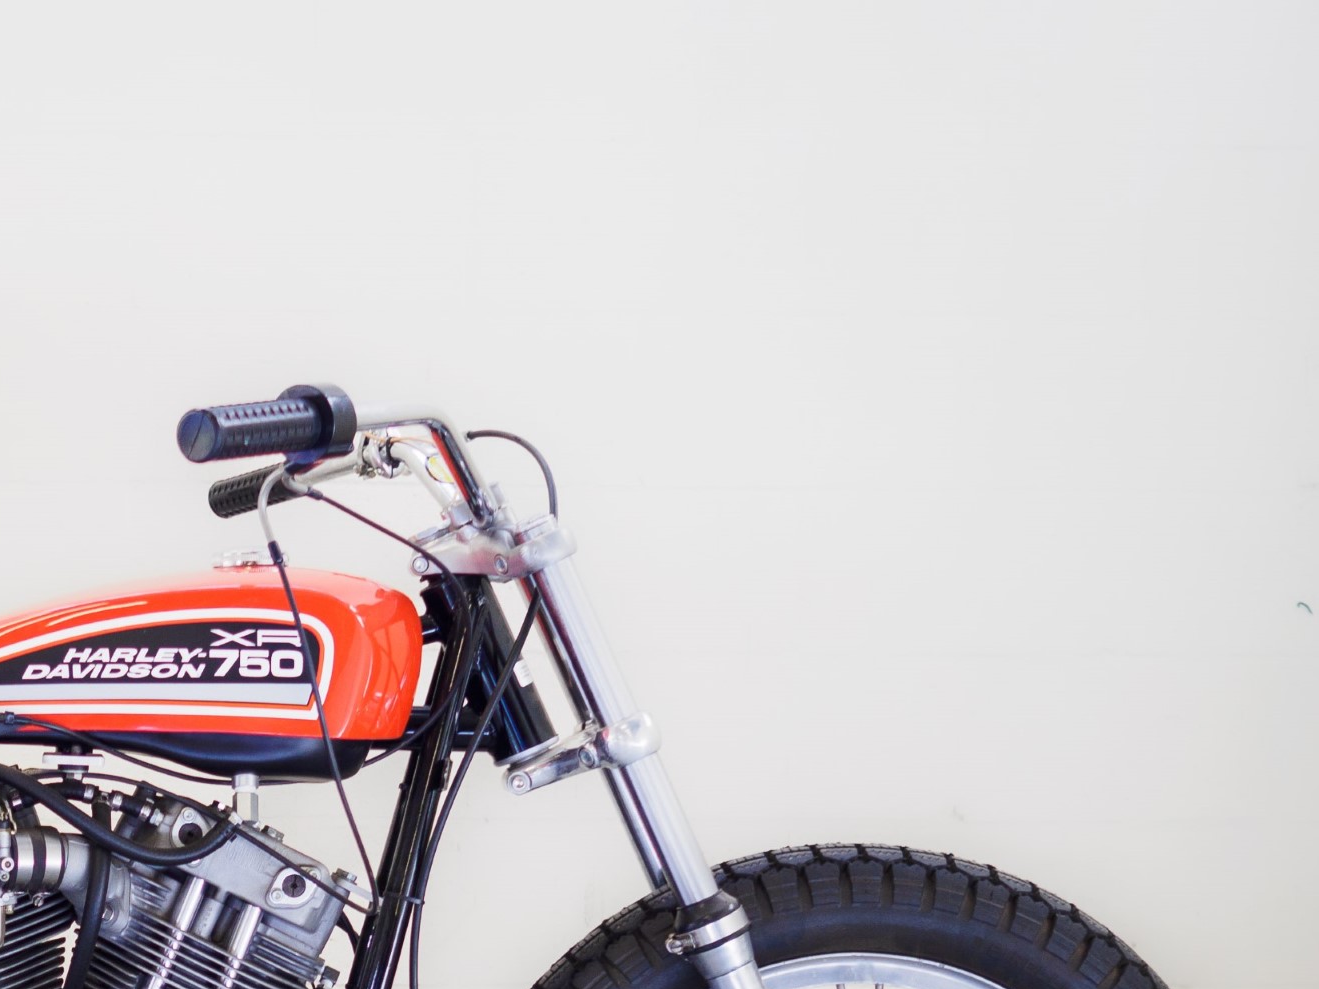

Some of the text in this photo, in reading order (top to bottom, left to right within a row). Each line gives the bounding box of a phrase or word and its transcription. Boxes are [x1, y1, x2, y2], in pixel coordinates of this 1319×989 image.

[210, 628, 302, 647] XR
[63, 648, 207, 663] HARLEY-
[209, 649, 304, 678] 750
[22, 663, 206, 680] DAVIDSON
